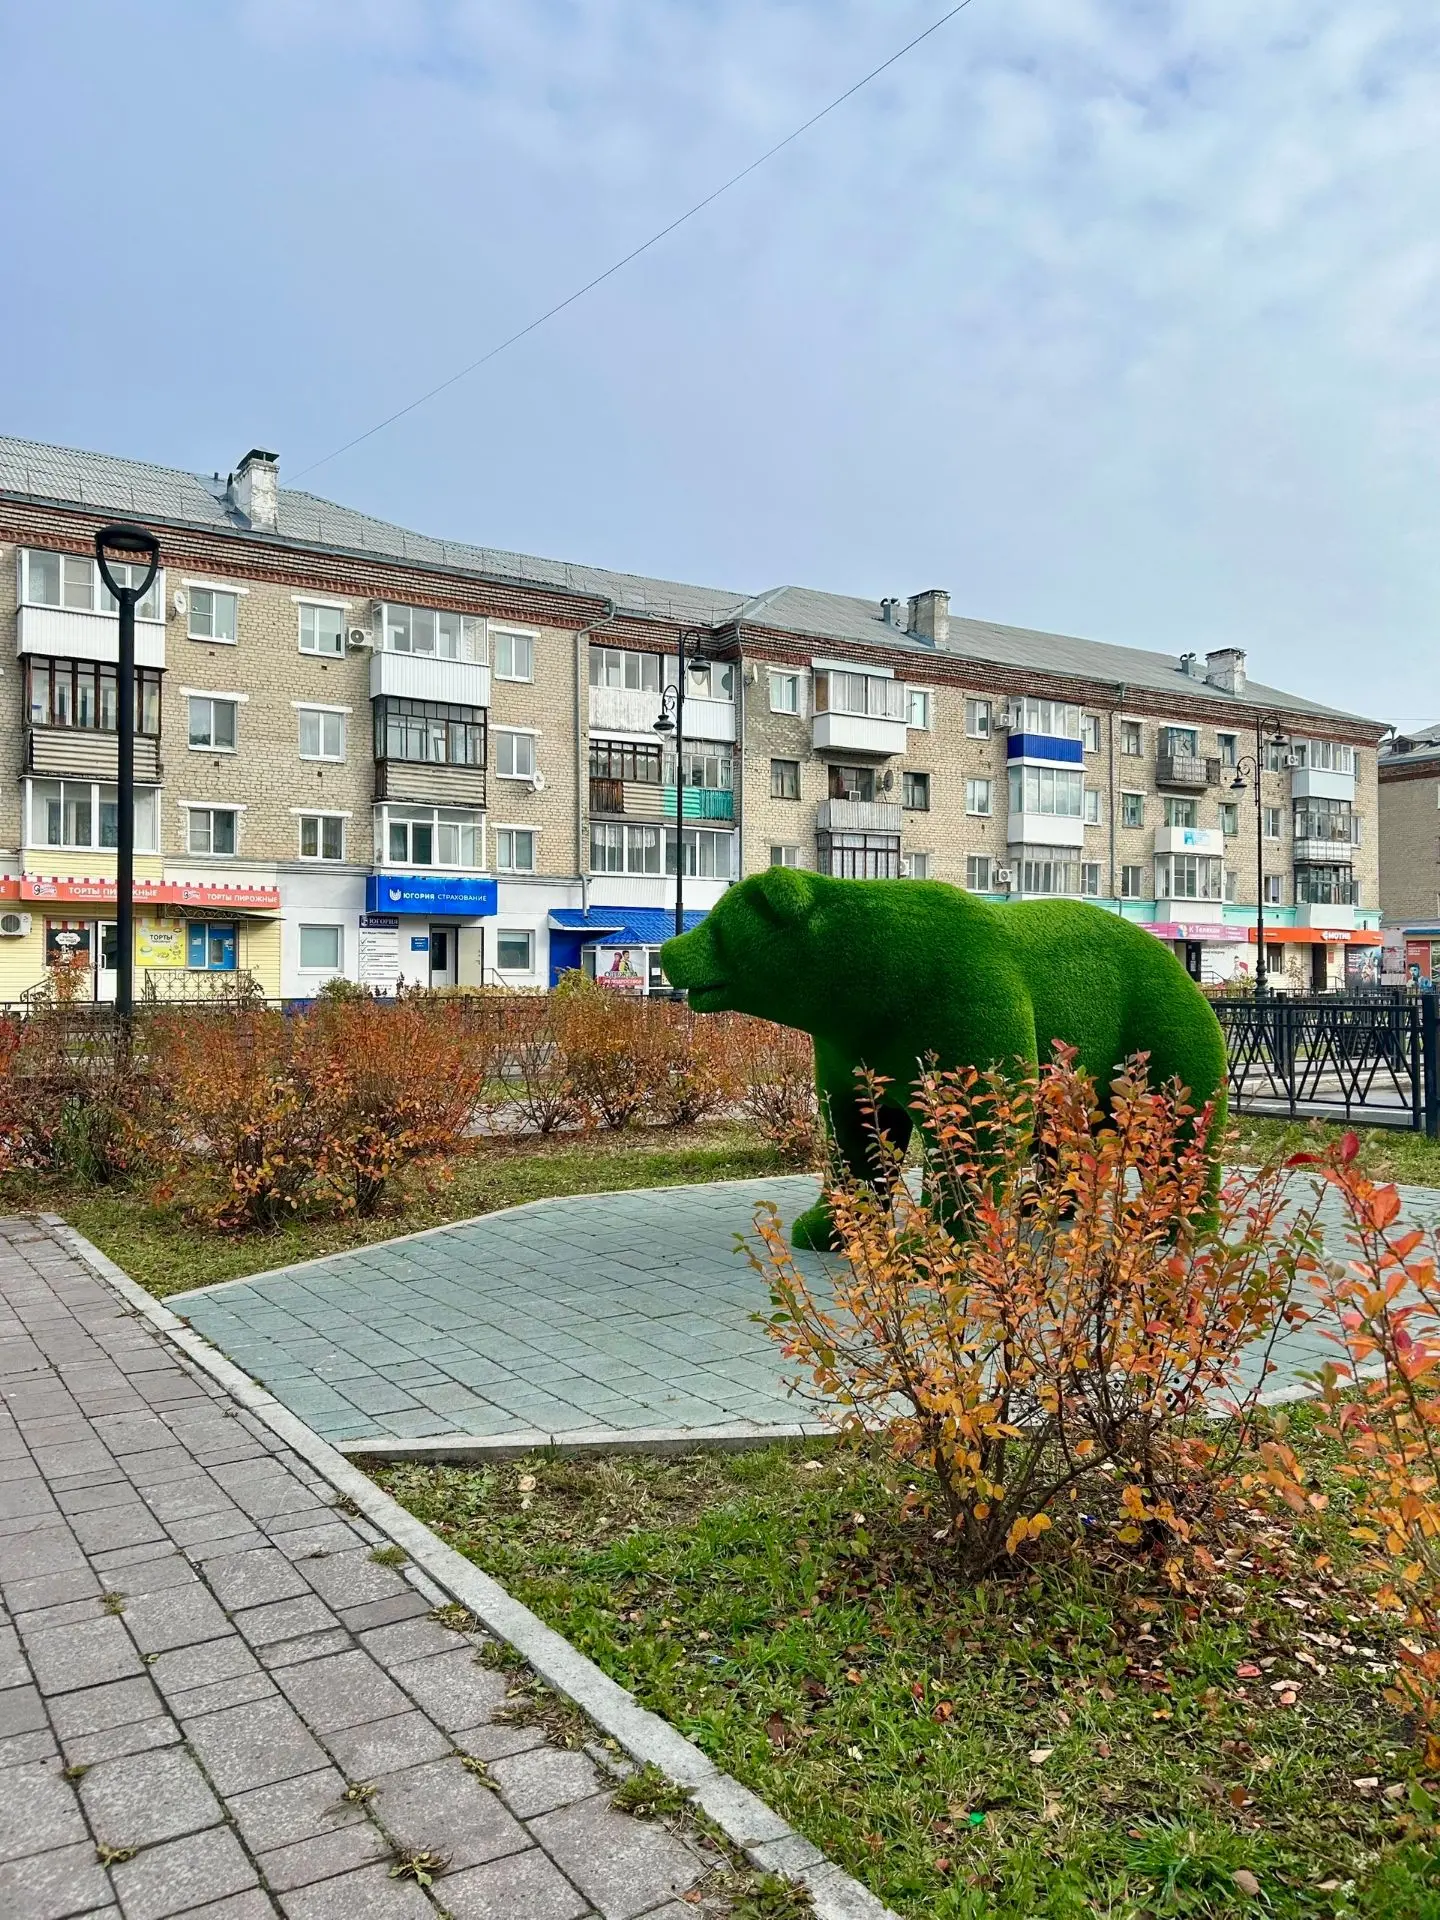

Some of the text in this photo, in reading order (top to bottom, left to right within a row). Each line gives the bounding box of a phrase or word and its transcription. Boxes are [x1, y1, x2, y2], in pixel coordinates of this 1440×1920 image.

[69, 886, 101, 896] ТОРТЫ
[102, 887, 159, 897] ПИЖНЫЕ
[403, 891, 487, 902] ЮГОРИЯ СТРАХОВАНИЕ
[207, 892, 232, 901] ТОРТЫ
[234, 894, 278, 904] ПИРОЖНЫЕ
